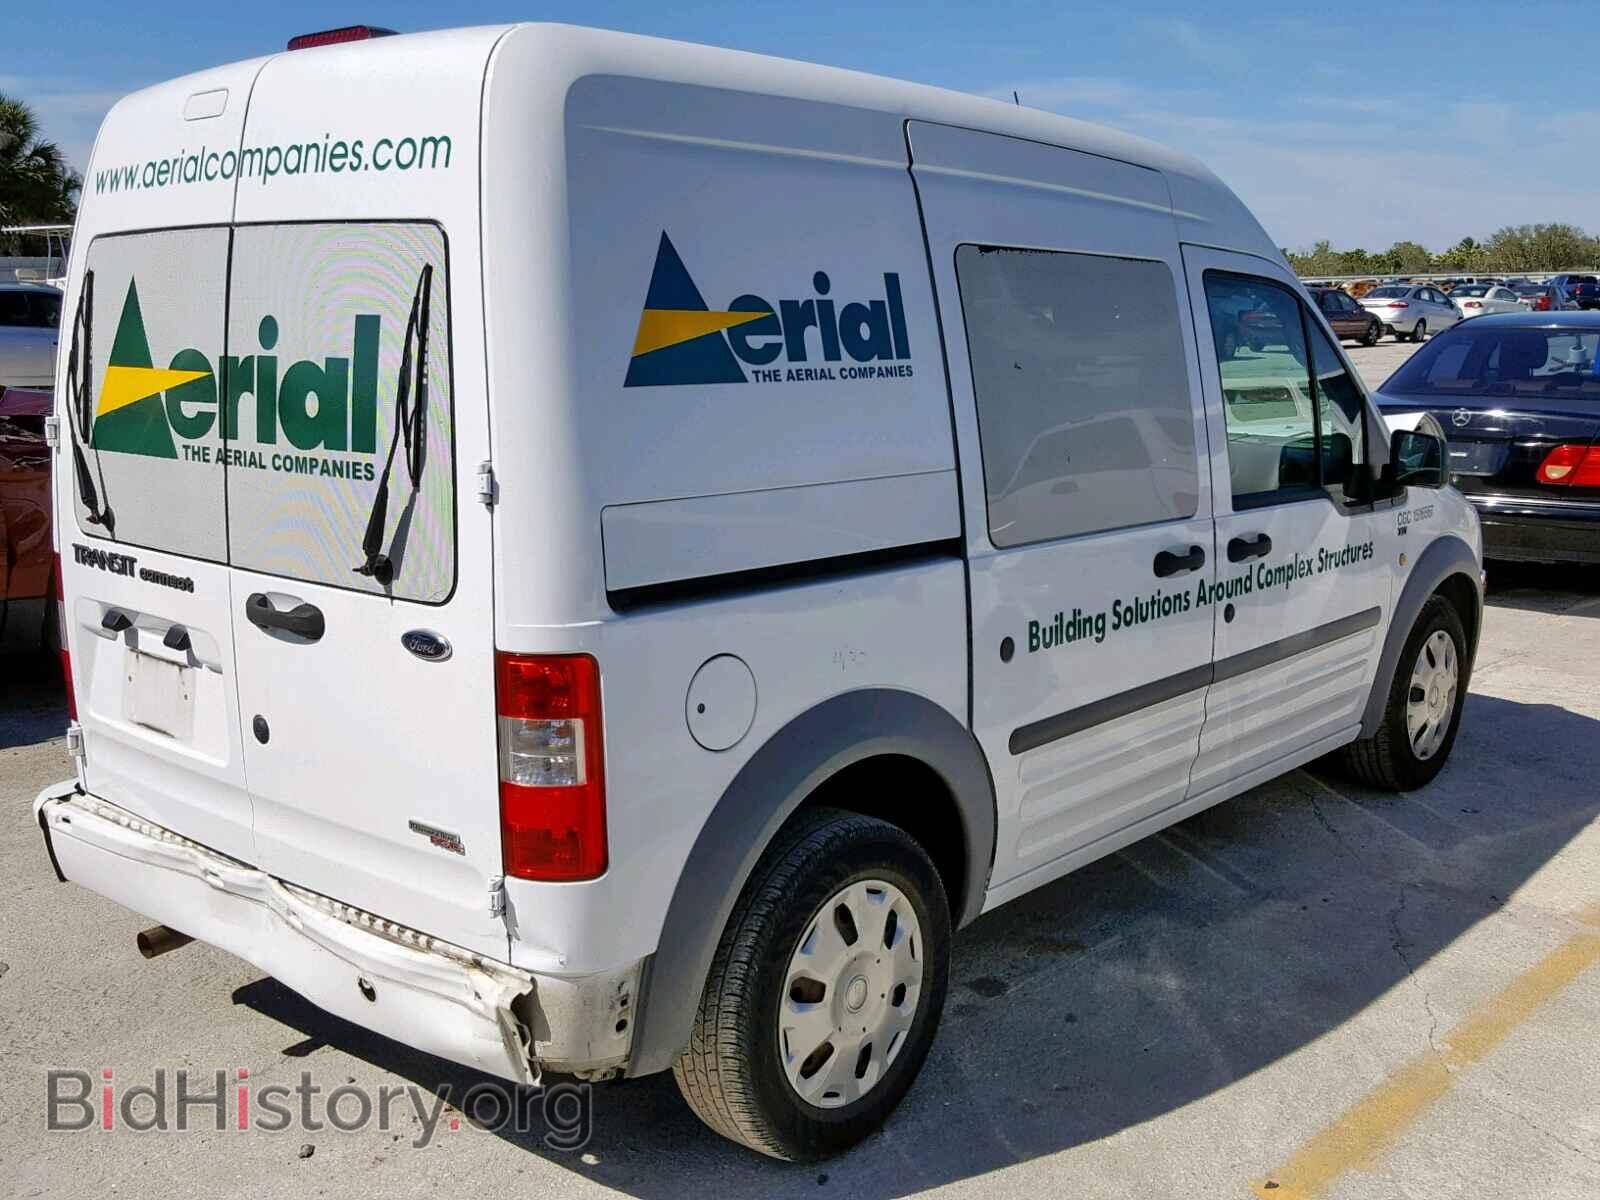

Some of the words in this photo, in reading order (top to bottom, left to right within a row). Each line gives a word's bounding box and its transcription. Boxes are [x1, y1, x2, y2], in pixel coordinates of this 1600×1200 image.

[95, 133, 452, 195] www.aerialcompanies.com
[623, 229, 911, 387] Aerial
[89, 275, 381, 459] Aerial
[752, 369, 782, 383] THE
[786, 367, 836, 382] AERIAL
[839, 365, 913, 380] COMPANIES
[182, 444, 212, 464] THE
[215, 447, 267, 470] AERIAL
[271, 453, 376, 482] COMPANIES
[72, 543, 138, 578] TRANSIT
[1028, 608, 1107, 653] Building
[1112, 588, 1190, 631] Solutions
[1196, 573, 1253, 609] Around
[1256, 553, 1314, 592] Complex
[1317, 539, 1374, 572] Structures
